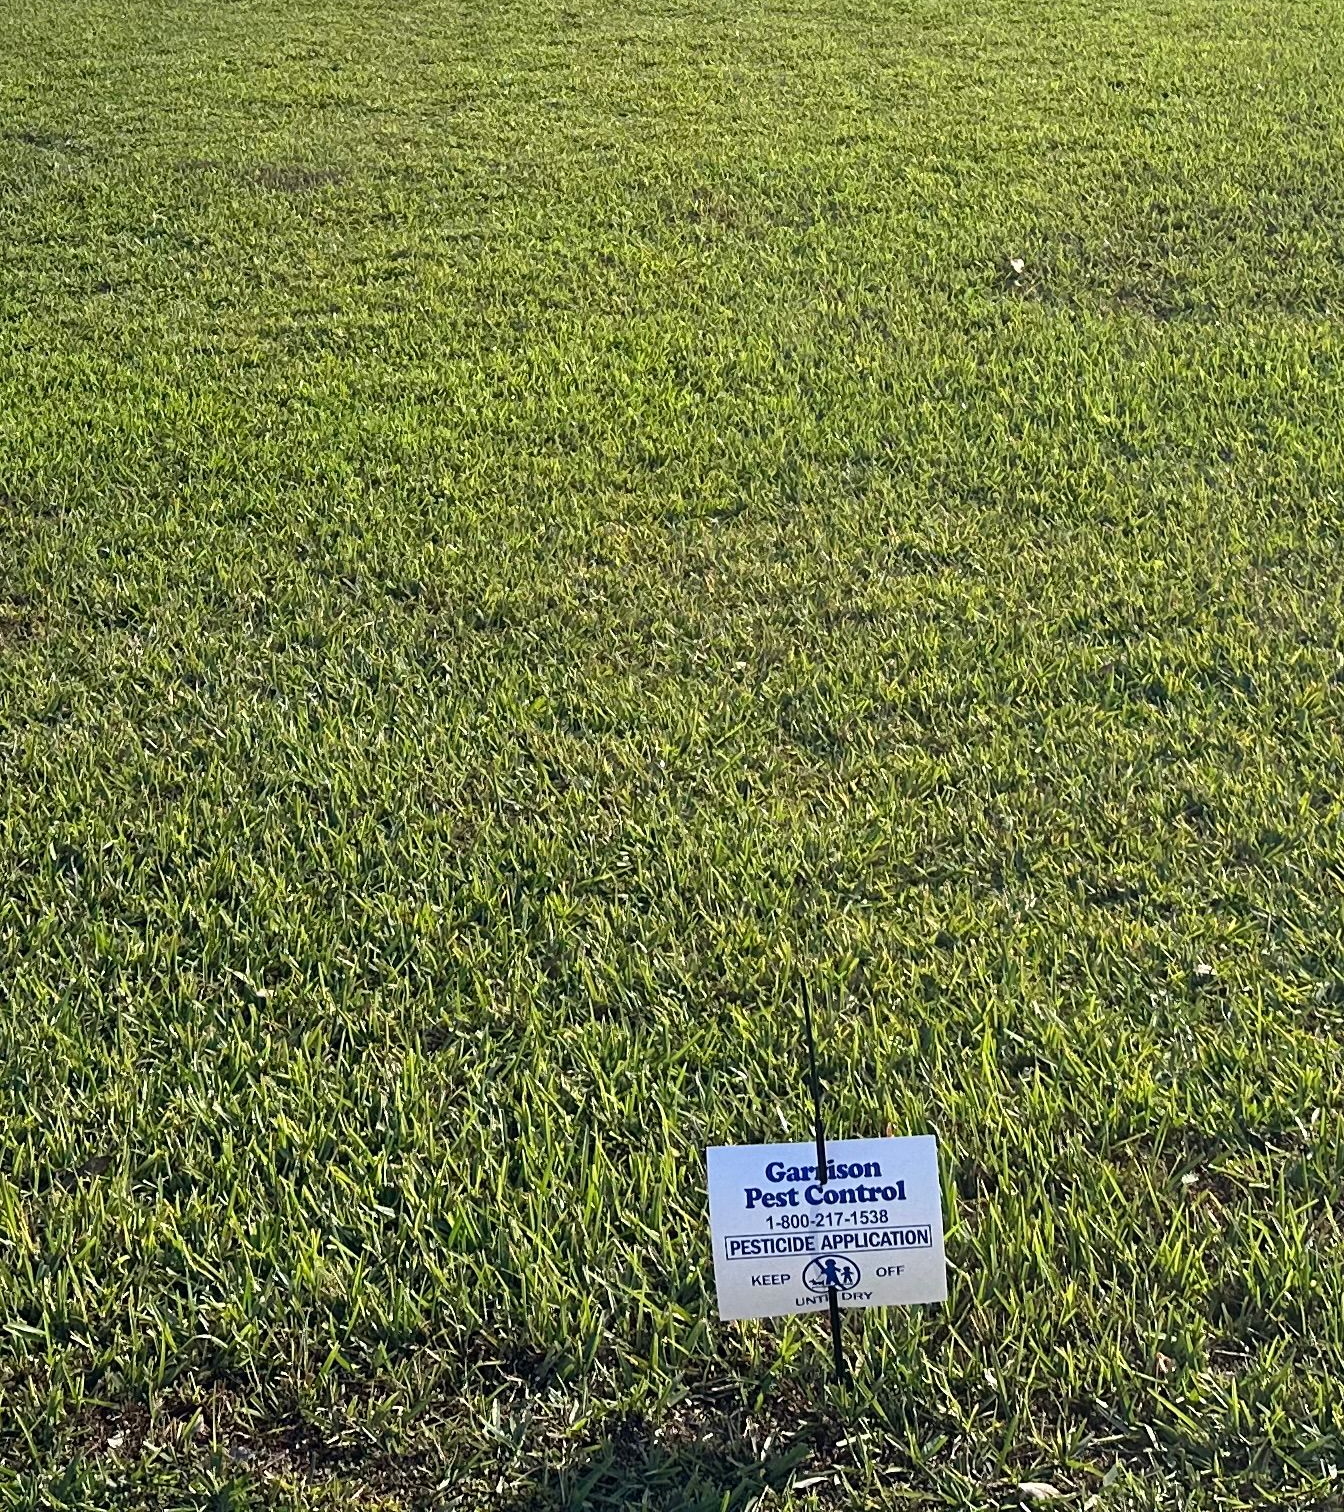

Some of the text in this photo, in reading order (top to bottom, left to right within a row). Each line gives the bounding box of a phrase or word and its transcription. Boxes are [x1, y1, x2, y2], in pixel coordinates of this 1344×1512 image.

[743, 1180, 907, 1209] Pest Control
[765, 1209, 889, 1230] 1-800-217-1538
[729, 1229, 929, 1256] PESTICIDE APPLICATION
[751, 1265, 905, 1287] KEEP OFF
[795, 1291, 873, 1307] UNTI DRY
